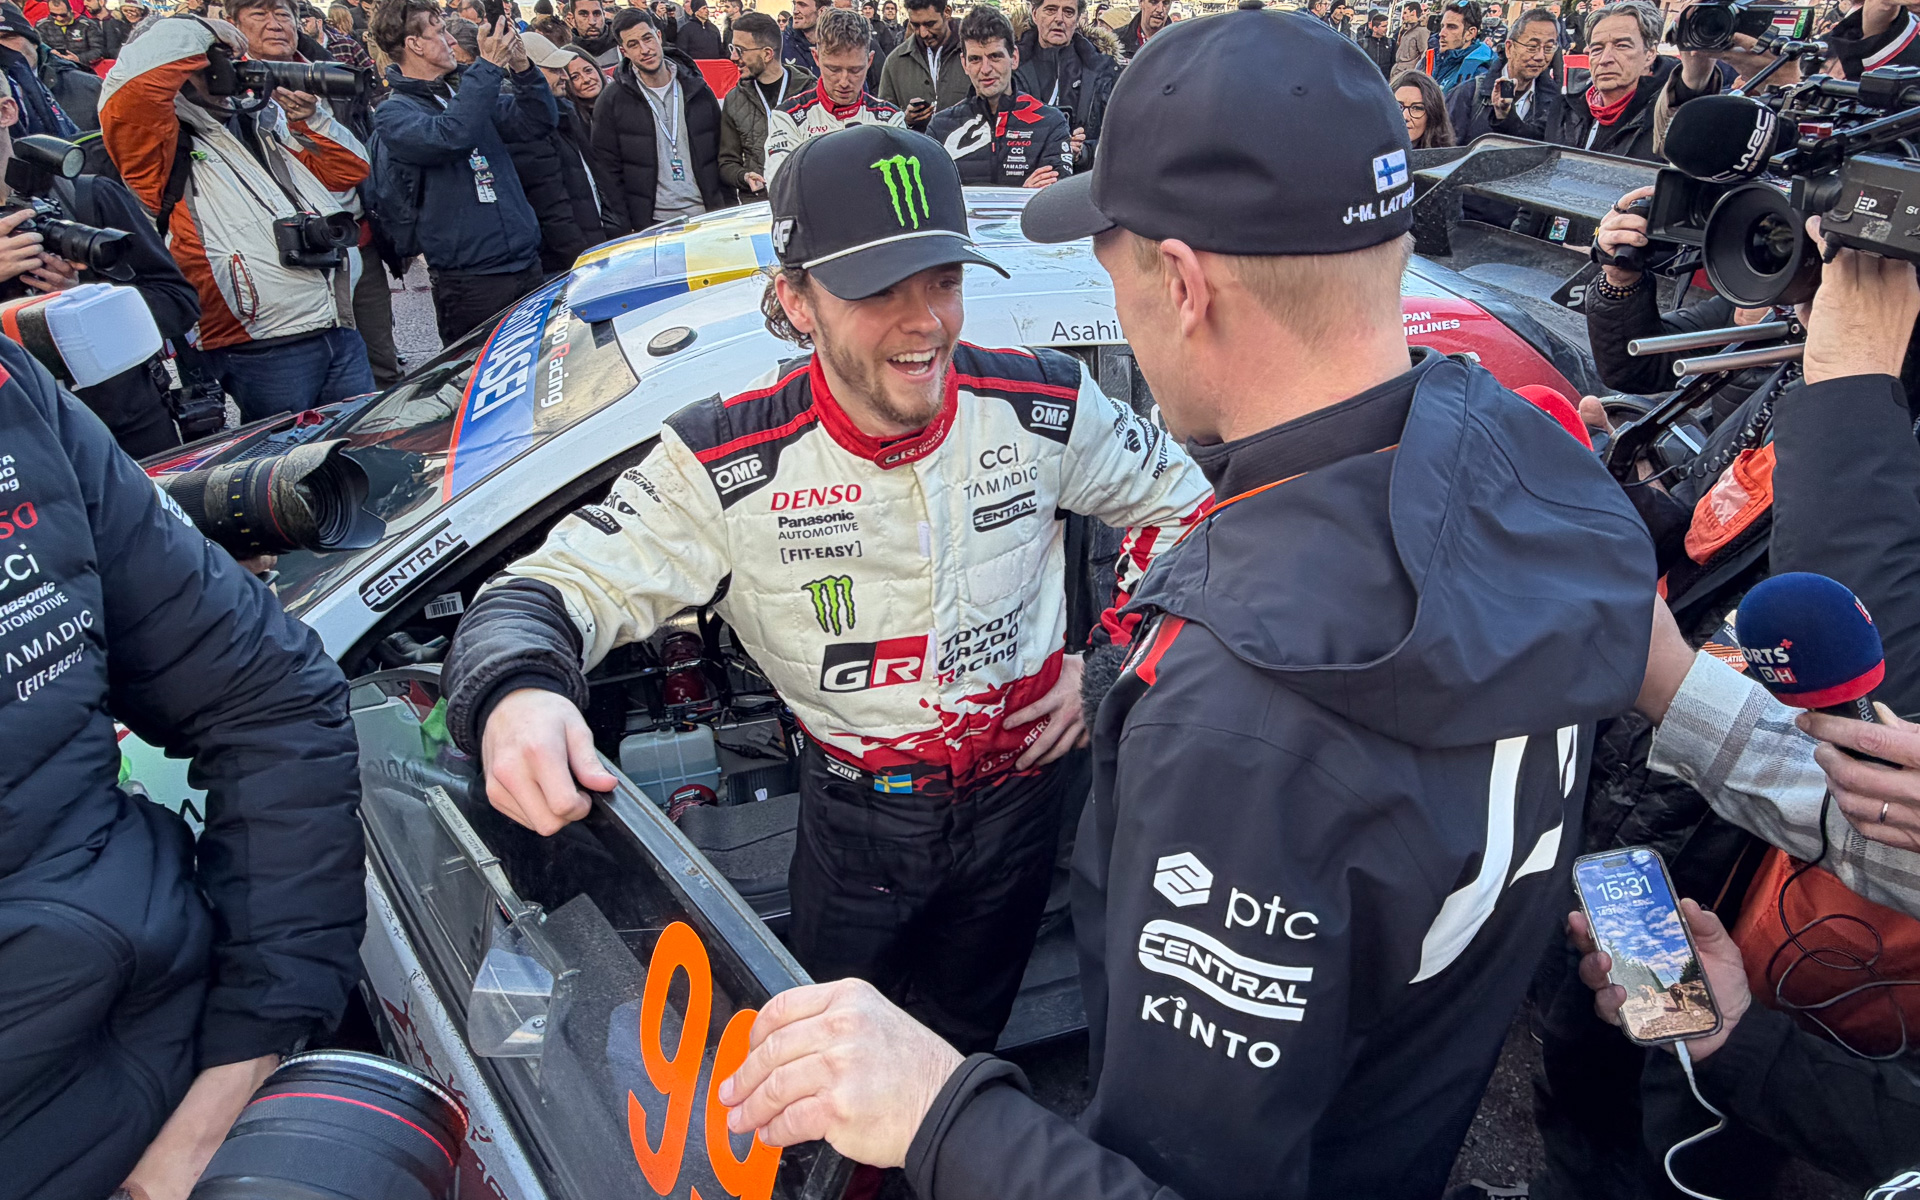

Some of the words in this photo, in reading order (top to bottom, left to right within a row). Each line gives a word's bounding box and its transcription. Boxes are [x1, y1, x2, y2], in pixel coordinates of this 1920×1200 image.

[1343, 203, 1376, 225] J-M.
[1567, 285, 1586, 307] S
[1051, 320, 1125, 341] Asahi
[1402, 311, 1431, 323] PAN
[1403, 319, 1460, 336] IRLINES
[541, 342, 571, 409] Racing
[1031, 405, 1069, 427] OMP
[716, 459, 763, 488] OMP
[963, 465, 1038, 500] TAMADIC
[770, 484, 862, 511] DENSO
[0, 501, 38, 539] SO
[778, 509, 854, 529] Panasonic
[973, 499, 1037, 526] CENTRAL
[778, 522, 859, 540] AUTOMOTIVE
[361, 532, 463, 607] CENTRAL
[0, 581, 56, 618] nasonic
[0, 609, 93, 680] AMADIC
[937, 621, 1019, 672] GAZOO
[823, 656, 921, 691] GR
[932, 641, 1018, 687] Racing
[1596, 875, 1653, 901] 15:31
[1225, 887, 1319, 940] ptc
[1139, 932, 1307, 1005] CENTRAL
